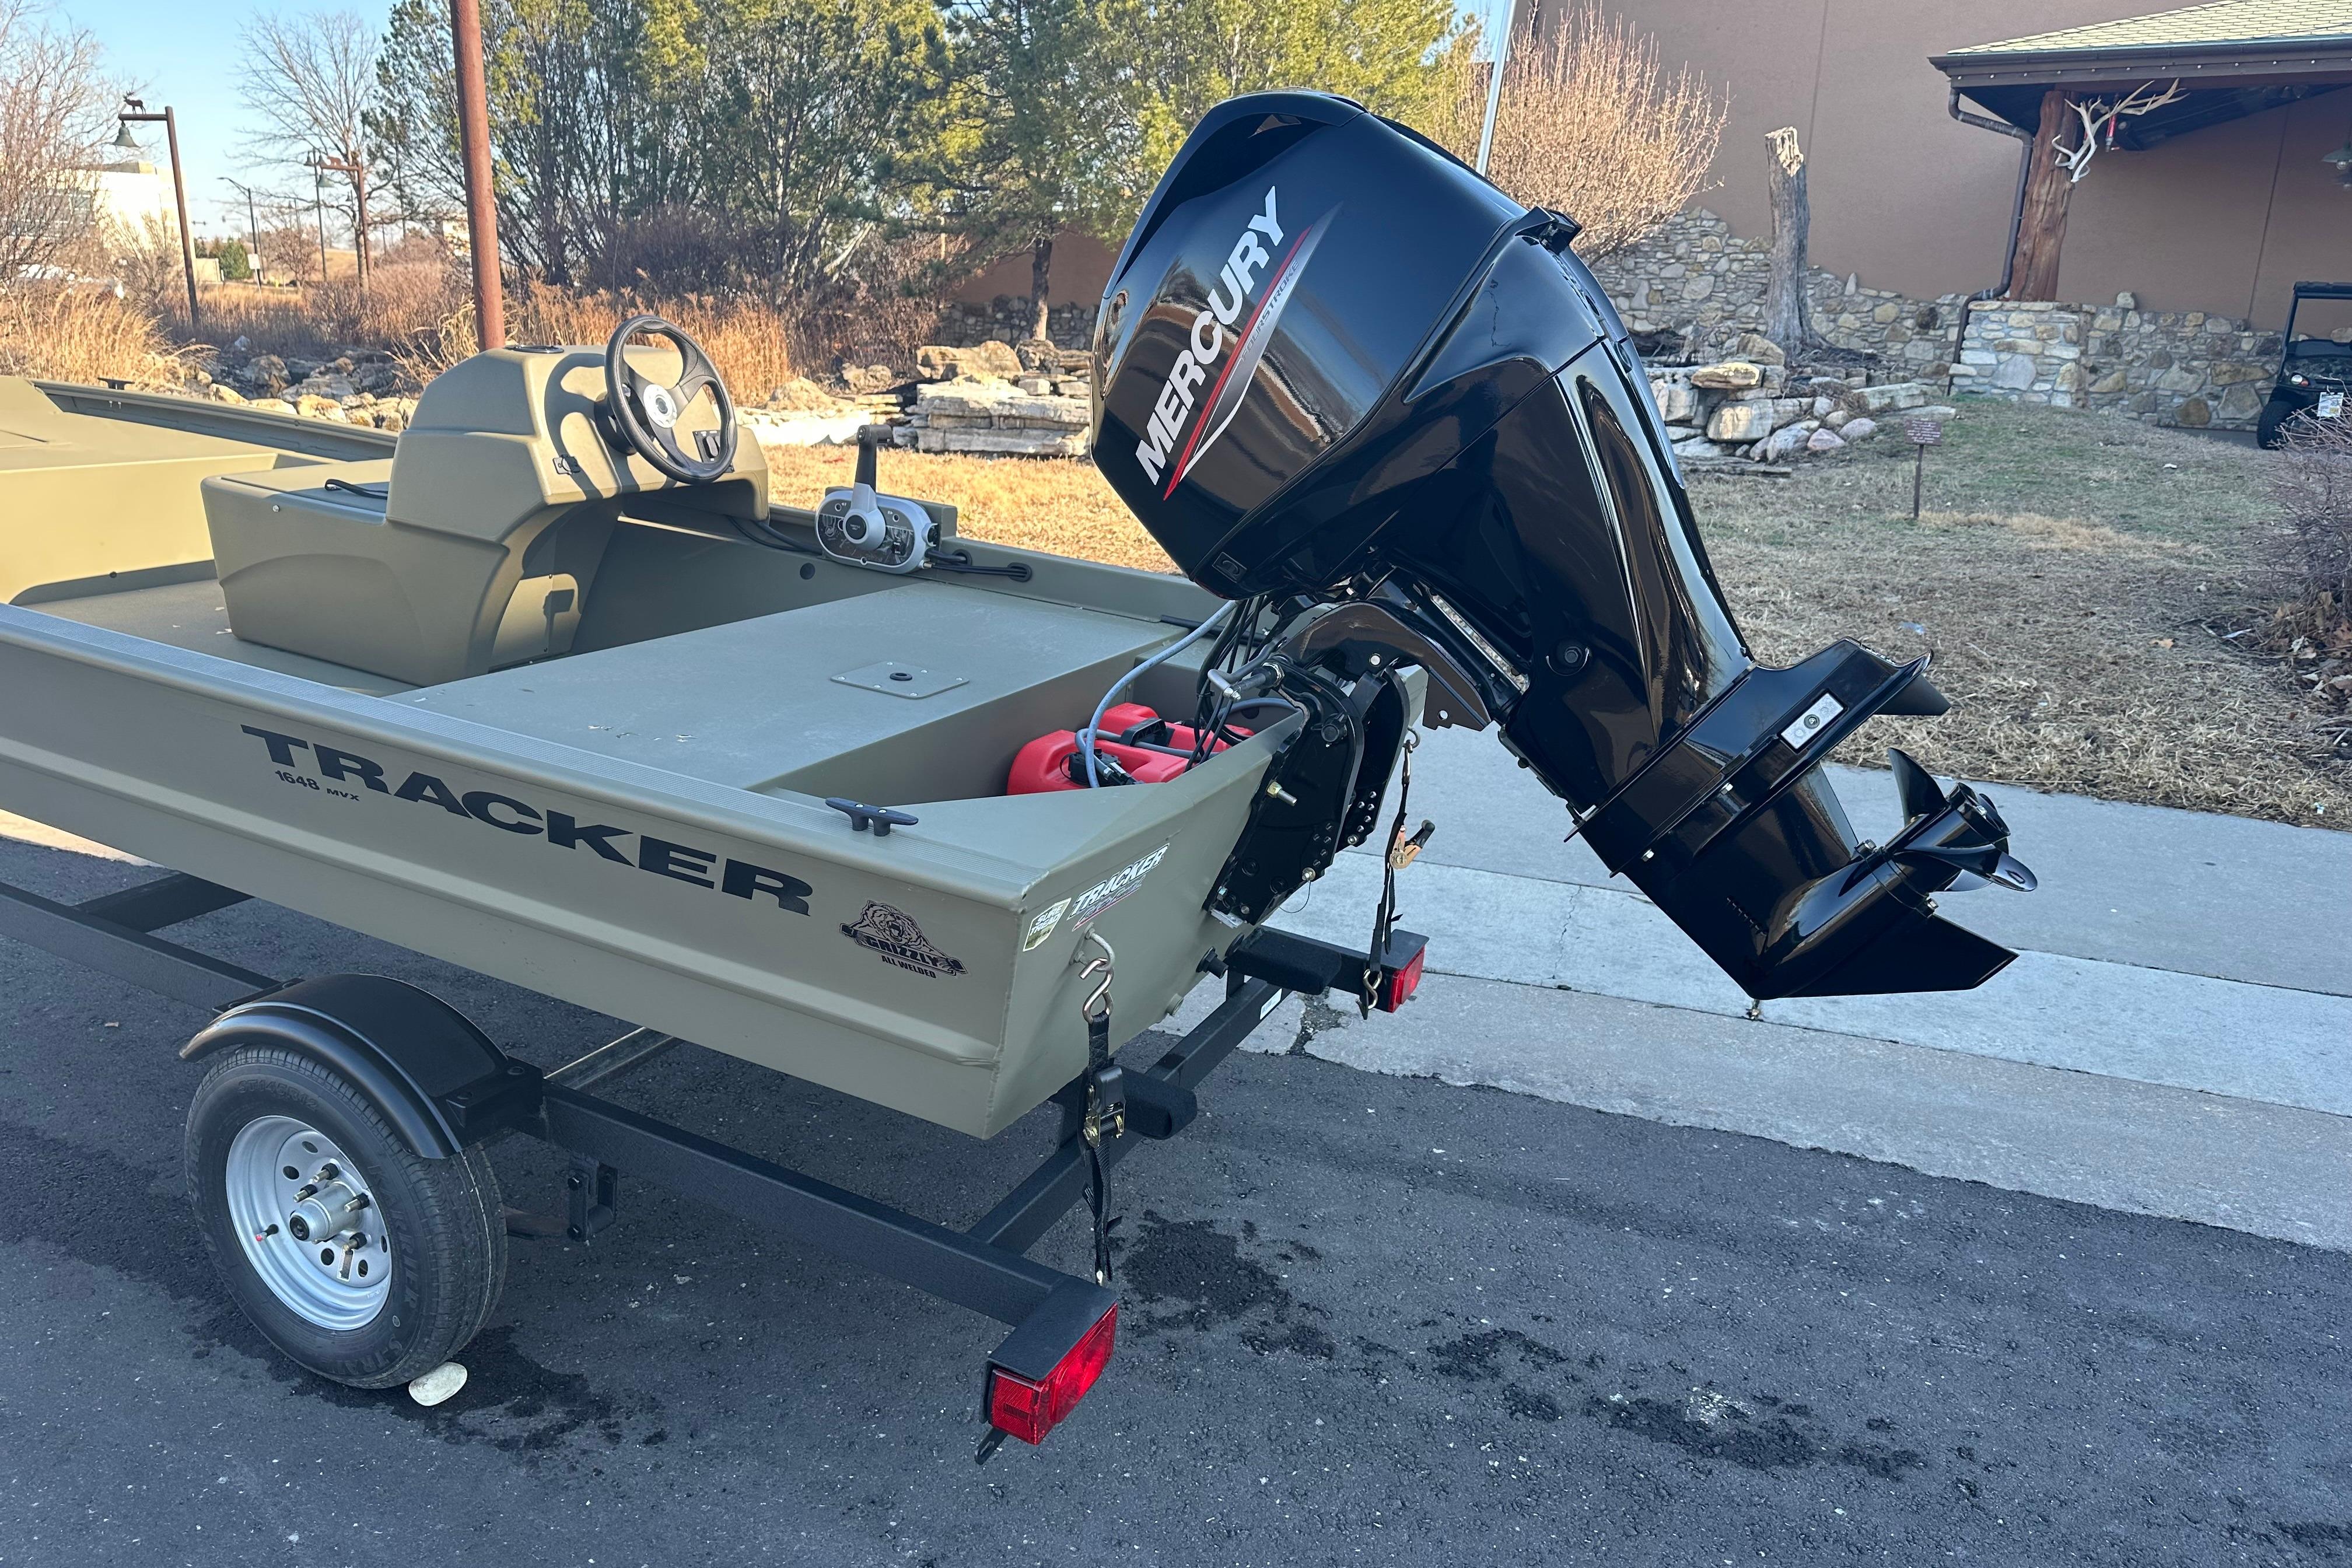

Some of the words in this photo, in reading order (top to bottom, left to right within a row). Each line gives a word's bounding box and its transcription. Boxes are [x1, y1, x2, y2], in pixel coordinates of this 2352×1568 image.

[1241, 260, 1299, 362] FOURSTROKE
[1135, 186, 1284, 485] MERCURY
[275, 770, 320, 790] 1648
[326, 788, 360, 802] MVX
[240, 724, 814, 916] TRACKER
[1070, 846, 1168, 918] TRACKER
[1030, 912, 1061, 936] TREAD
[1035, 905, 1063, 926] SURE
[867, 937, 938, 967] GRIZZLY
[881, 955, 898, 966] ALL
[898, 960, 937, 979] WELDED
[237, 1079, 318, 1111] ST145R12
[368, 1164, 420, 1310] KARRIER
